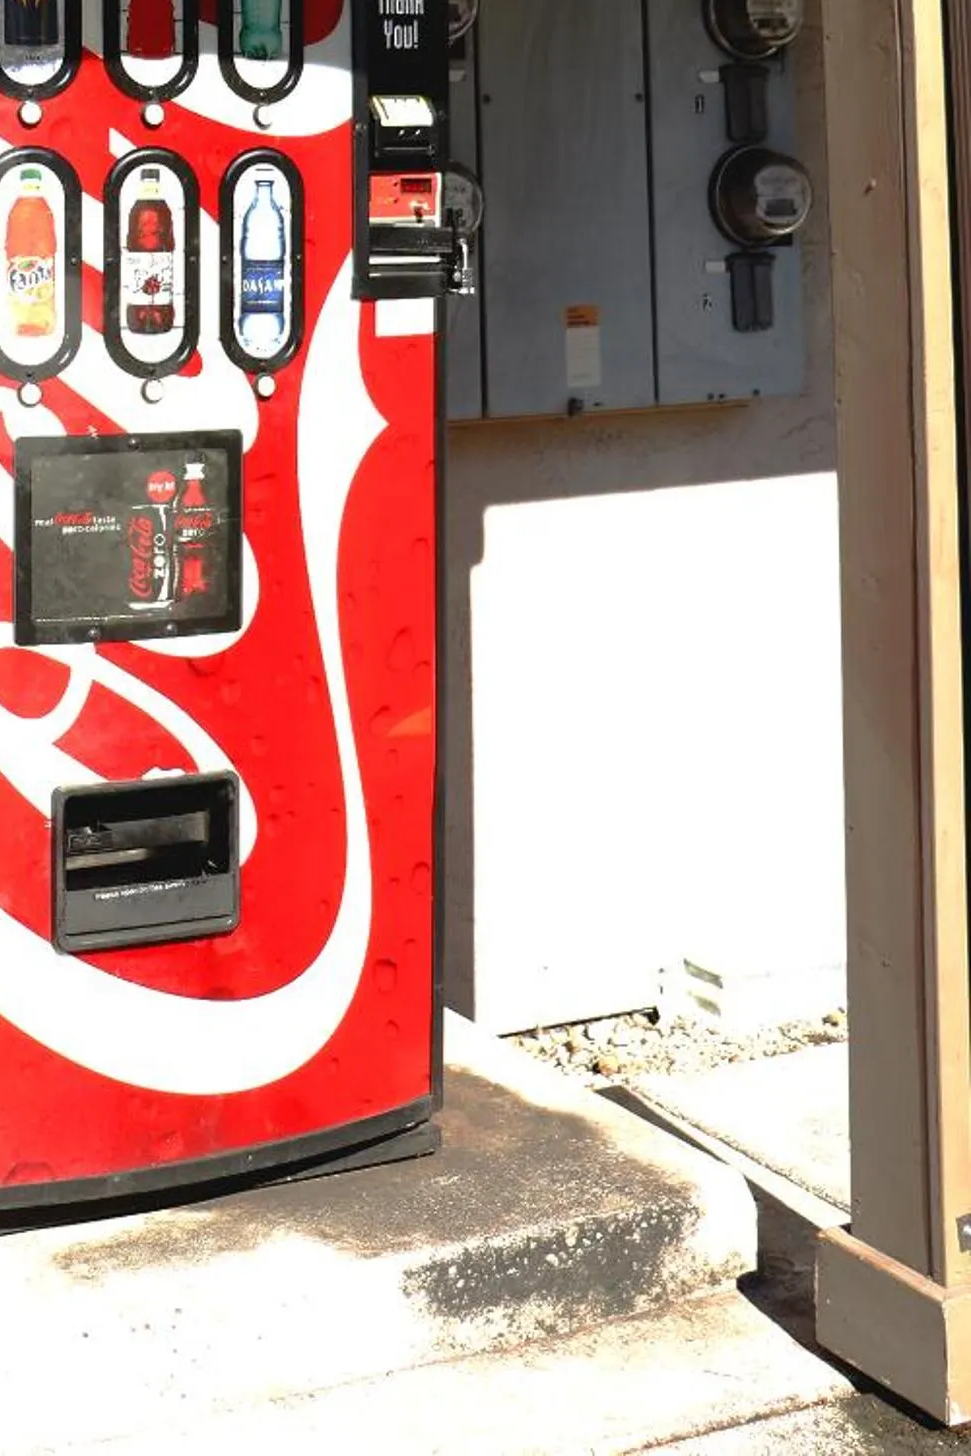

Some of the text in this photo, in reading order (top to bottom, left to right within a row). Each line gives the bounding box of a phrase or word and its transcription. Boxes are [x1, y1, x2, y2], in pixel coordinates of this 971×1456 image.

[384, 19, 418, 49] You!
[128, 515, 153, 599] Coca-Cola
[153, 533, 166, 579] zero
